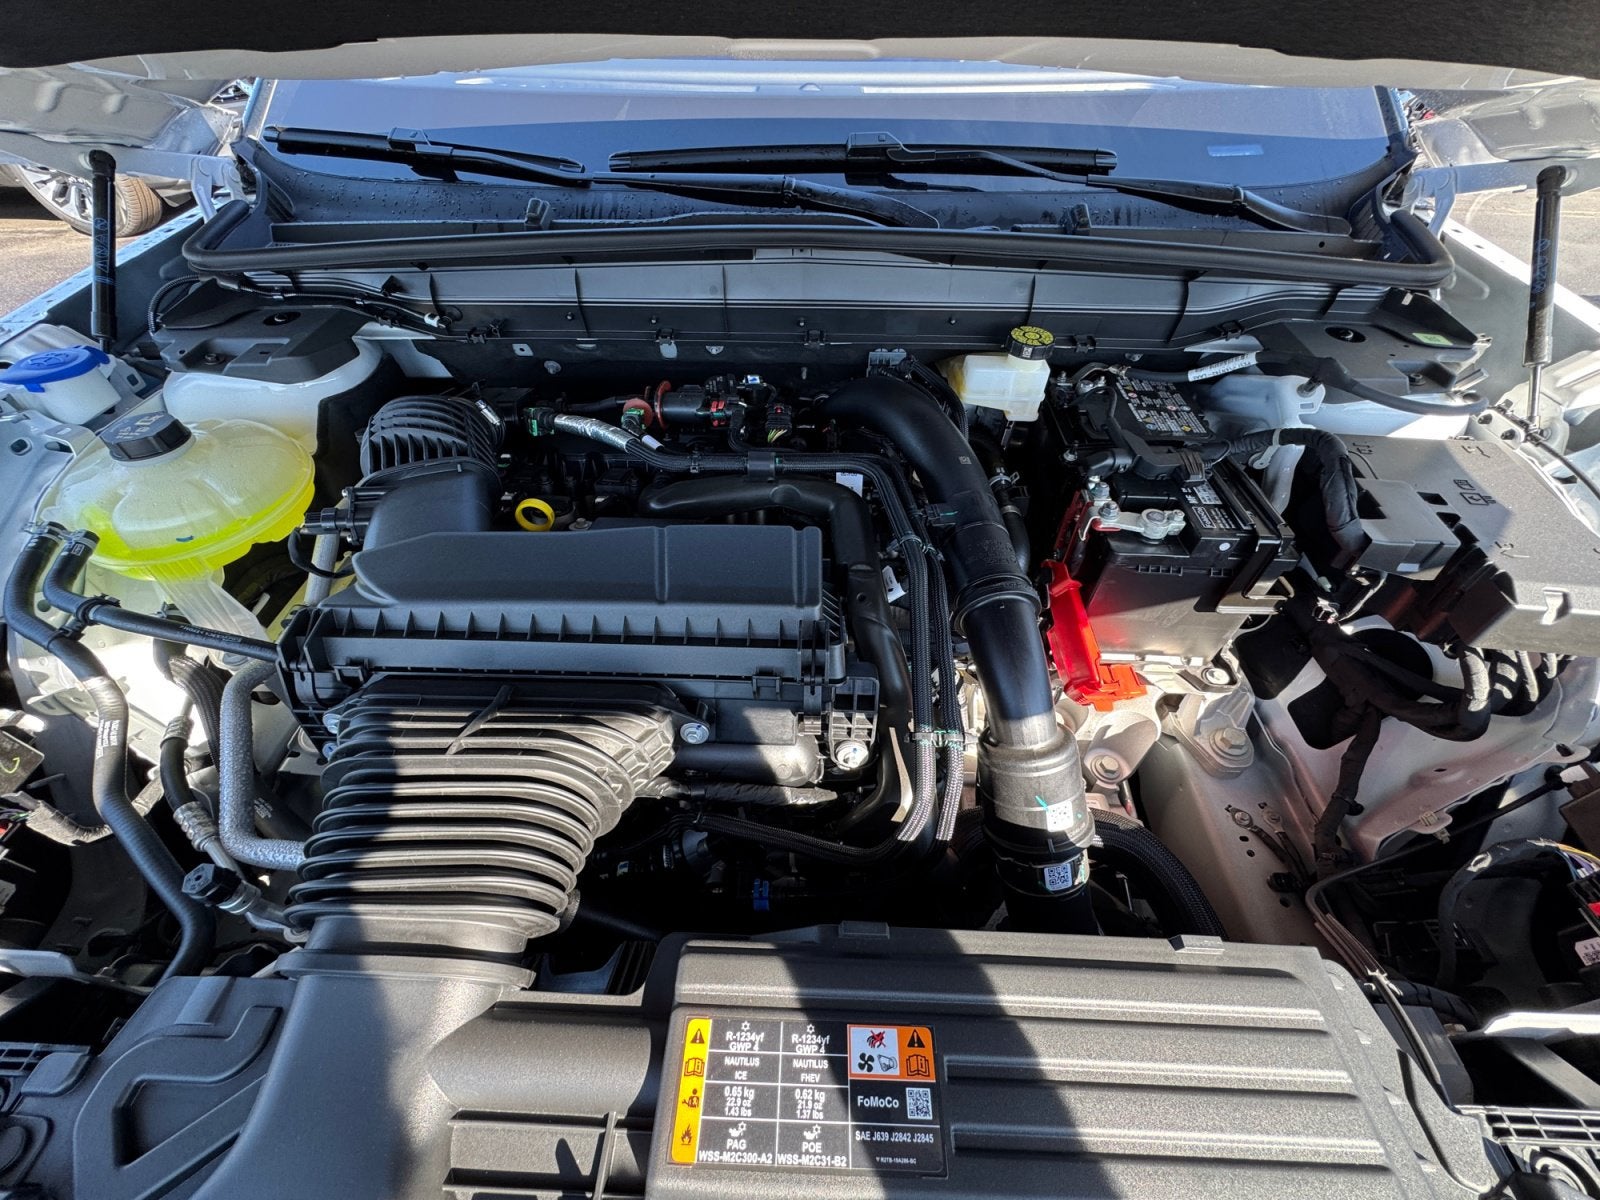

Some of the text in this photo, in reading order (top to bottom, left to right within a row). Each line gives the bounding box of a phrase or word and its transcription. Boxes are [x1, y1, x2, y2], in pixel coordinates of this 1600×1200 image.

[726, 1031, 765, 1045] R-1234yf
[791, 1034, 830, 1046] R-1234yf
[729, 1041, 752, 1051] GWP
[796, 1044, 826, 1055] GWP 4
[724, 1056, 760, 1067] NAUTILUS
[792, 1059, 829, 1069] NAUTILUS
[734, 1070, 748, 1080] ICE
[800, 1073, 821, 1083] FHEV
[724, 1086, 755, 1100] 0.65 kg
[795, 1088, 826, 1103] 0.62 kg
[726, 1097, 752, 1107] 22.9 oz
[797, 1100, 823, 1110] 21.9 oz
[857, 1095, 900, 1109] FoMoCo
[725, 1106, 752, 1117] 1.43 lbs
[796, 1109, 824, 1120] 1.37 lbs
[855, 1130, 935, 1144] SAE J639 J2842 J2845
[726, 1139, 747, 1150] PAG
[801, 1141, 823, 1153] POE
[698, 1150, 773, 1164] WSS-M2C300-A2
[777, 1153, 847, 1167] WSS-M2C31-B2
